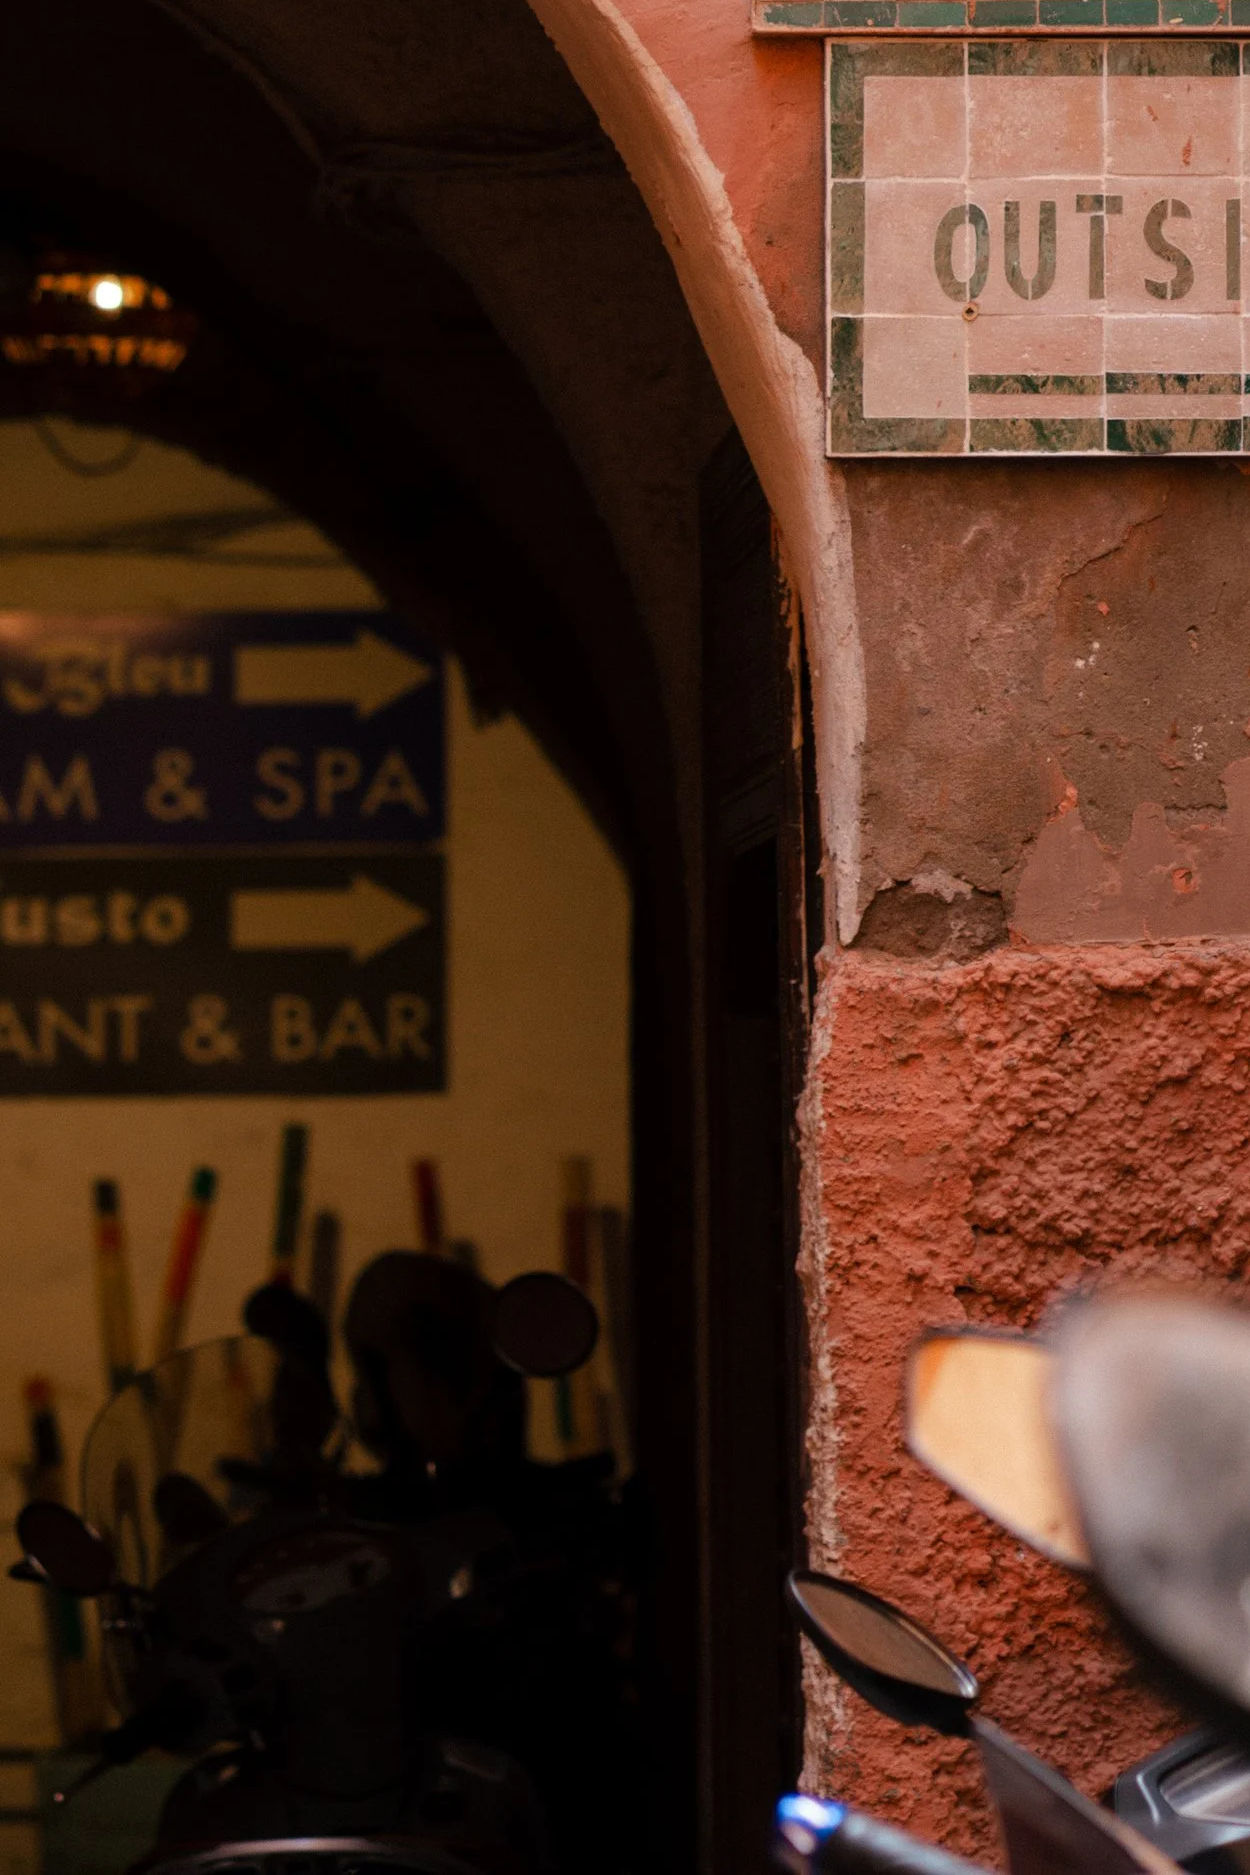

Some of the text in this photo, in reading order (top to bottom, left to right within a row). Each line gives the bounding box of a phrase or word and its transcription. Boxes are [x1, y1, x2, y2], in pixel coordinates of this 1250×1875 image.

[144, 747, 207, 822] &
[252, 746, 431, 822] SPA
[180, 993, 243, 1065] &
[270, 993, 432, 1065] BAR
